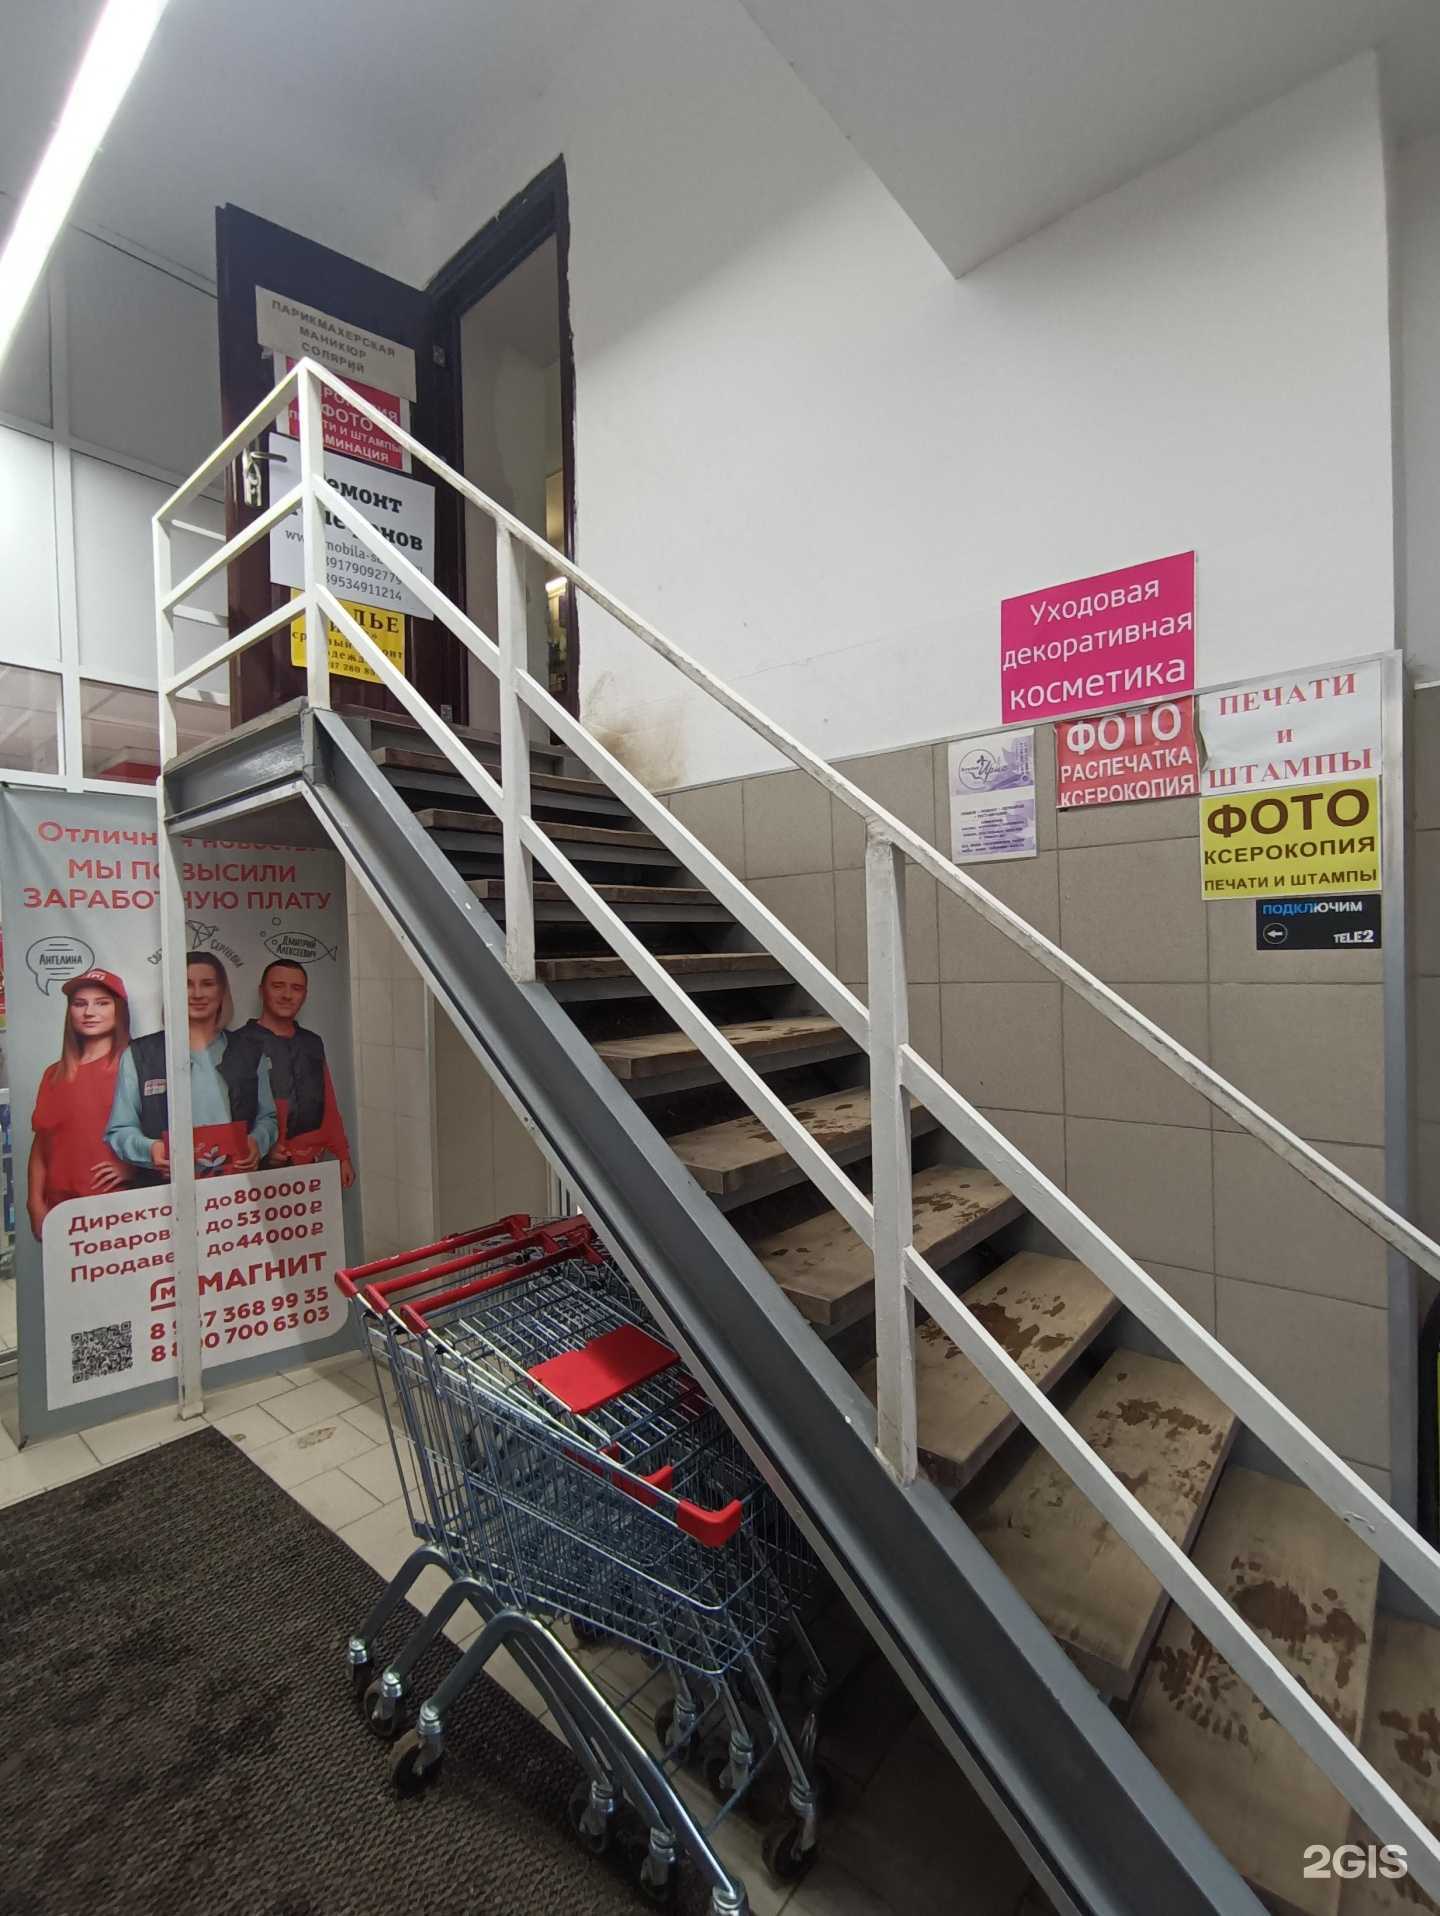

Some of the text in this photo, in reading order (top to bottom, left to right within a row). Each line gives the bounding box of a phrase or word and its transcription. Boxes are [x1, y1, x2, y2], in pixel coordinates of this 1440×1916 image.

[272, 300, 396, 357] ПАРИКМАХЕРСКАЯ
[300, 326, 367, 359] МАНИКЮР
[301, 342, 364, 374] СОЛЯРИЙ
[324, 433, 389, 463] МИНАЦИЯ
[324, 472, 402, 514] емонт
[1030, 579, 1160, 626] Уходовая
[1002, 612, 1193, 671] декоративная
[1010, 658, 1186, 710] косметика
[1219, 672, 1357, 716] ПЕЧАТИ
[1066, 702, 1182, 756] ФОТО
[1061, 745, 1193, 784] РАСПЕЧАТКА
[1208, 748, 1374, 789] ШТАМПЫ
[1060, 774, 1195, 807] КСЕРОКОПИЯ
[1207, 788, 1370, 838] ФОТО
[1204, 836, 1376, 865] КСЕРОКОПИЯ
[68, 859, 121, 880] МЫ
[1204, 869, 1377, 891] ПЕЧАТИ И ШТАМПЫ
[247, 891, 332, 911] ПЛАТУ
[1262, 901, 1363, 916] ПОДКЛЮЧИМ
[1333, 930, 1375, 944] TELE2
[68, 1205, 172, 1236] Директо
[69, 1229, 171, 1257] Товаров
[71, 1251, 175, 1283] Продаве
[198, 1251, 327, 1296] МАГНИТ
[223, 1300, 266, 1324] 368
[271, 1292, 298, 1312] 99
[304, 1286, 328, 1305] 35
[224, 1320, 269, 1344] 700
